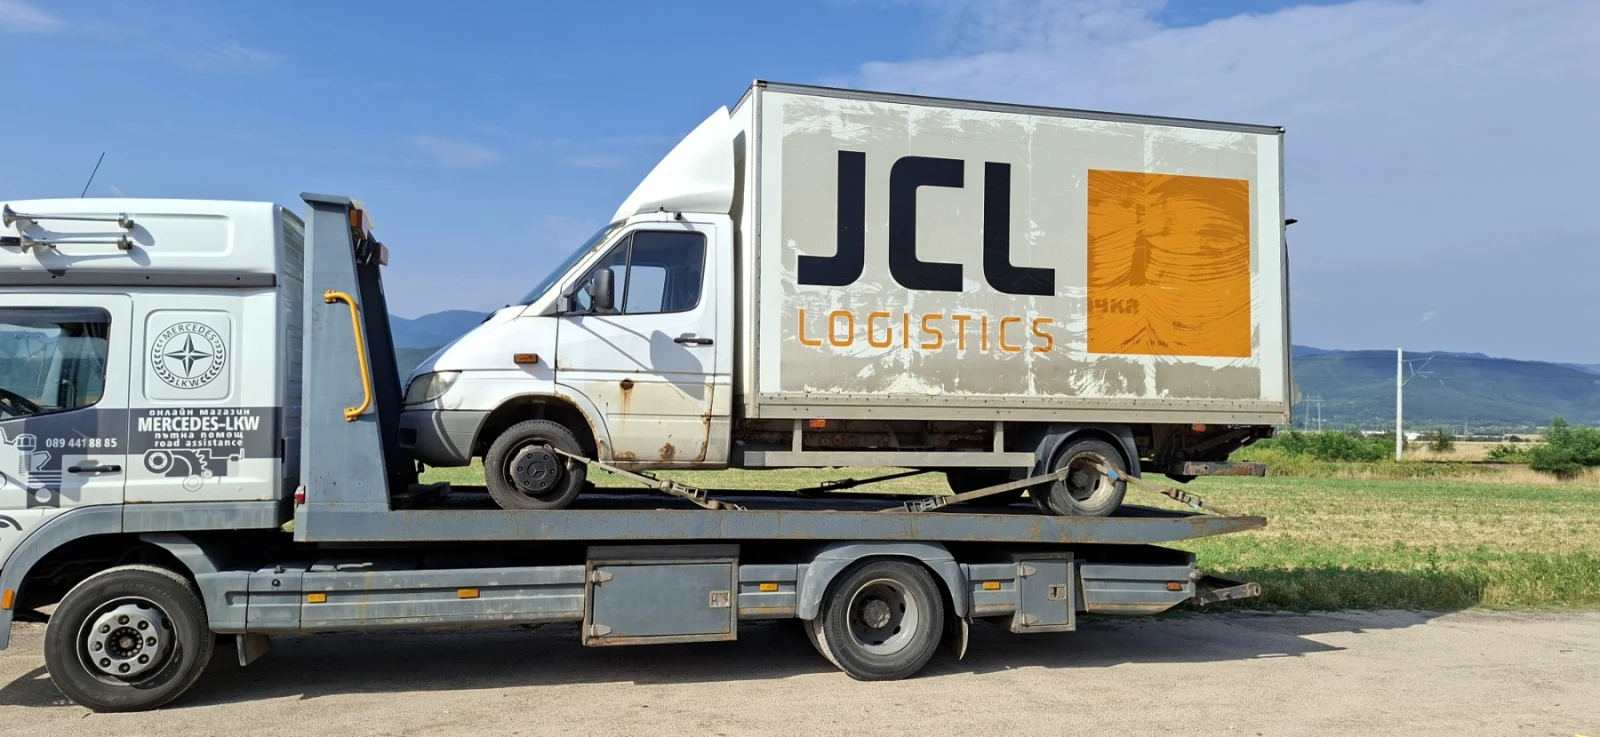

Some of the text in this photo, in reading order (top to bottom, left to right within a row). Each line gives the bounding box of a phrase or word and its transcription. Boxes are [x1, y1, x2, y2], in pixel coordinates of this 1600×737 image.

[797, 149, 1056, 297] JCL
[162, 323, 217, 341] MERCEDES
[798, 308, 1055, 353] LOGISTICS
[175, 378, 199, 387] LKW
[148, 408, 194, 416] онлайн
[138, 416, 260, 432] MERCEDES-LKW
[154, 431, 243, 440] пътна помощ
[46, 438, 118, 448] 089 441 88 85
[154, 439, 243, 448] road assistance
